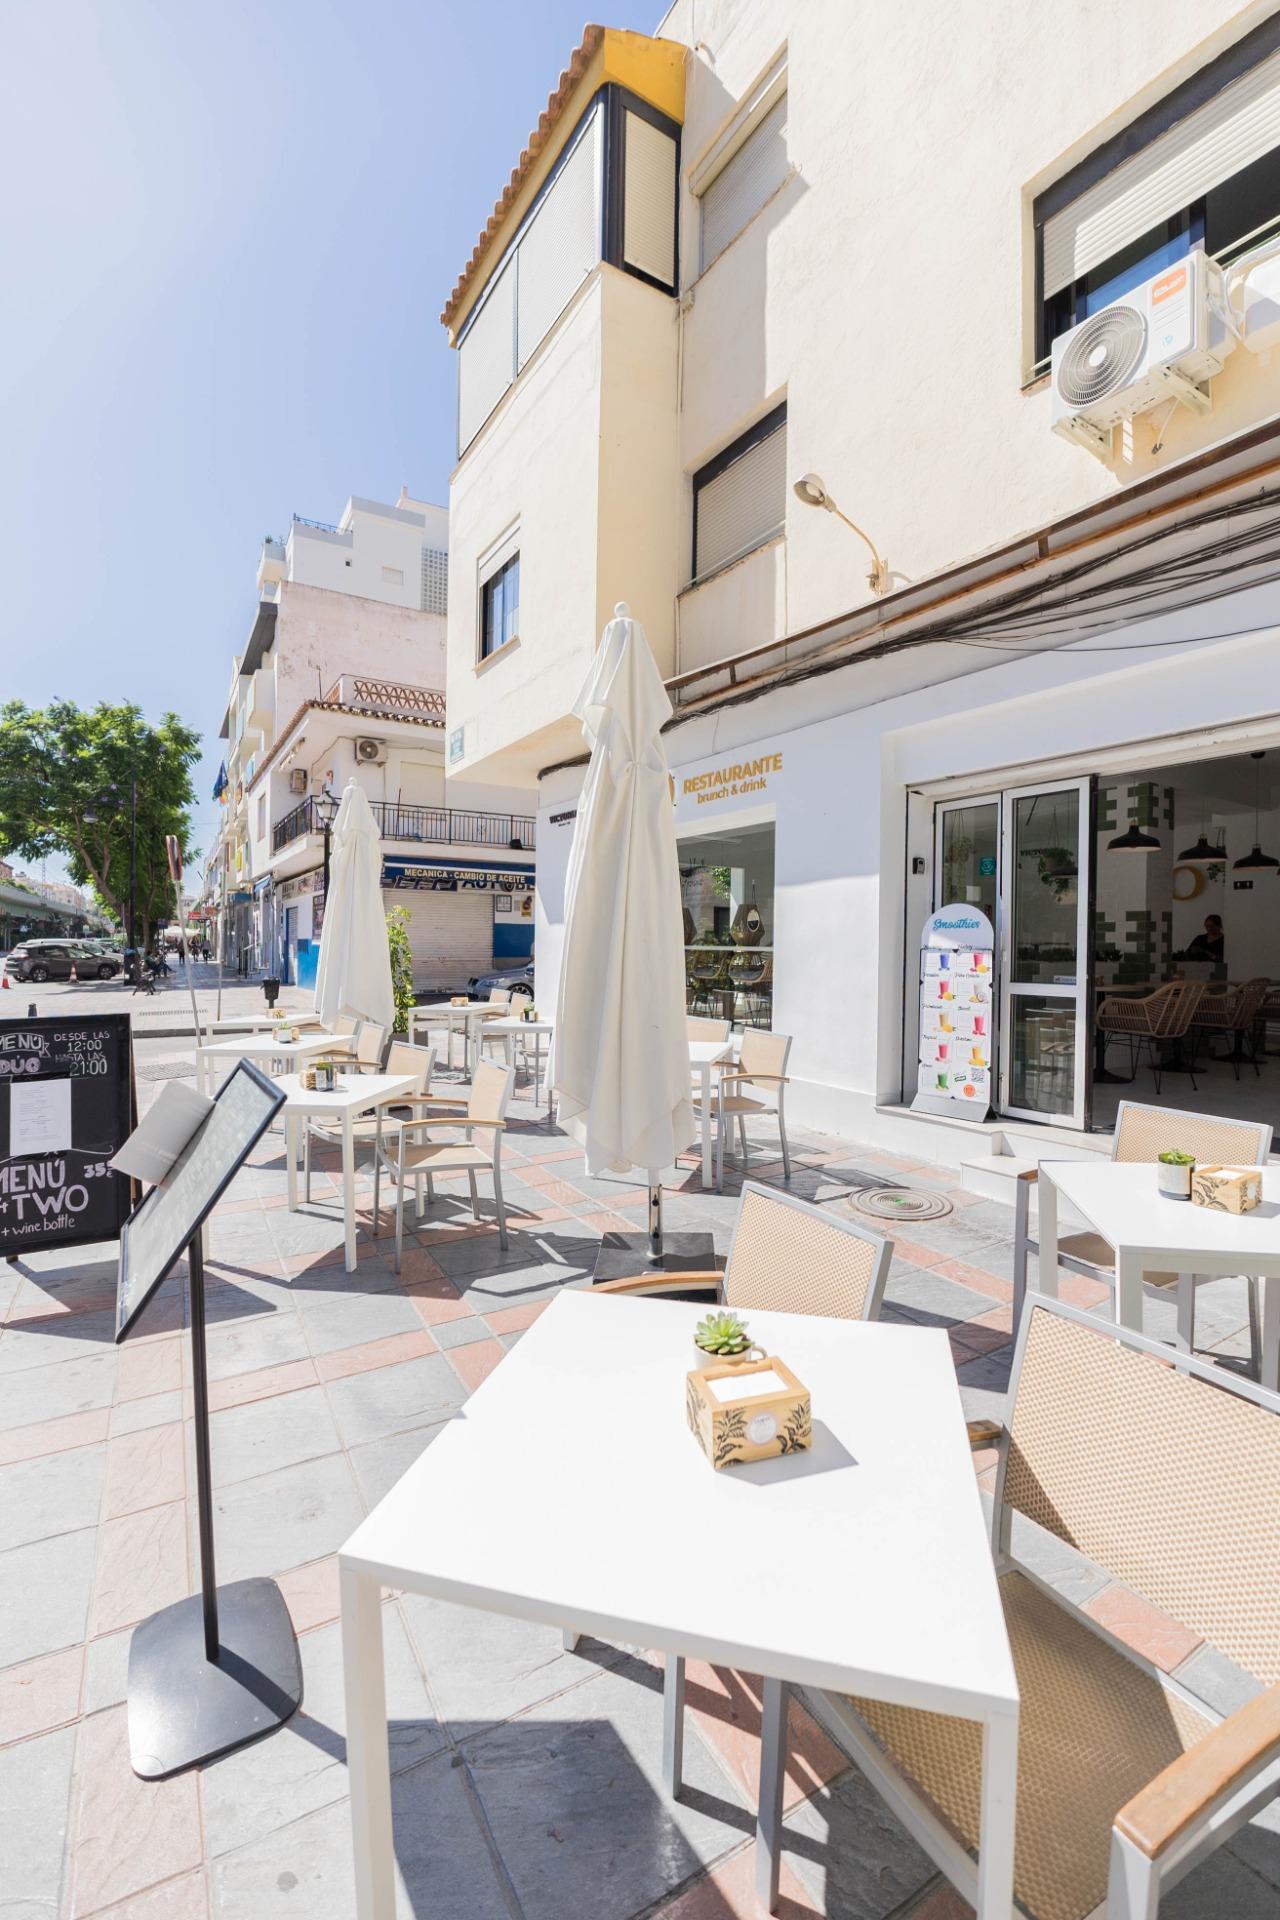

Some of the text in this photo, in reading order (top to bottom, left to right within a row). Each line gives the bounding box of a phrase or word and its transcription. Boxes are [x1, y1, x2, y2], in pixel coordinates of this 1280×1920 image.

[684, 752, 783, 794] RESTAURANTE
[697, 776, 767, 804] brunch & drink
[404, 868, 448, 879] MECANICA
[453, 871, 484, 881] CAMBIO
[486, 873, 497, 883] DE
[499, 875, 526, 884] ACEITE
[933, 917, 980, 931] Smoothies
[54, 1030, 110, 1042] DESDE LAS
[67, 1040, 102, 1053] 12:00
[55, 1051, 106, 1063] HASTA LAS
[70, 1059, 107, 1077] 21:00
[12, 1222, 41, 1235] wine
[43, 1213, 76, 1231] bottle
